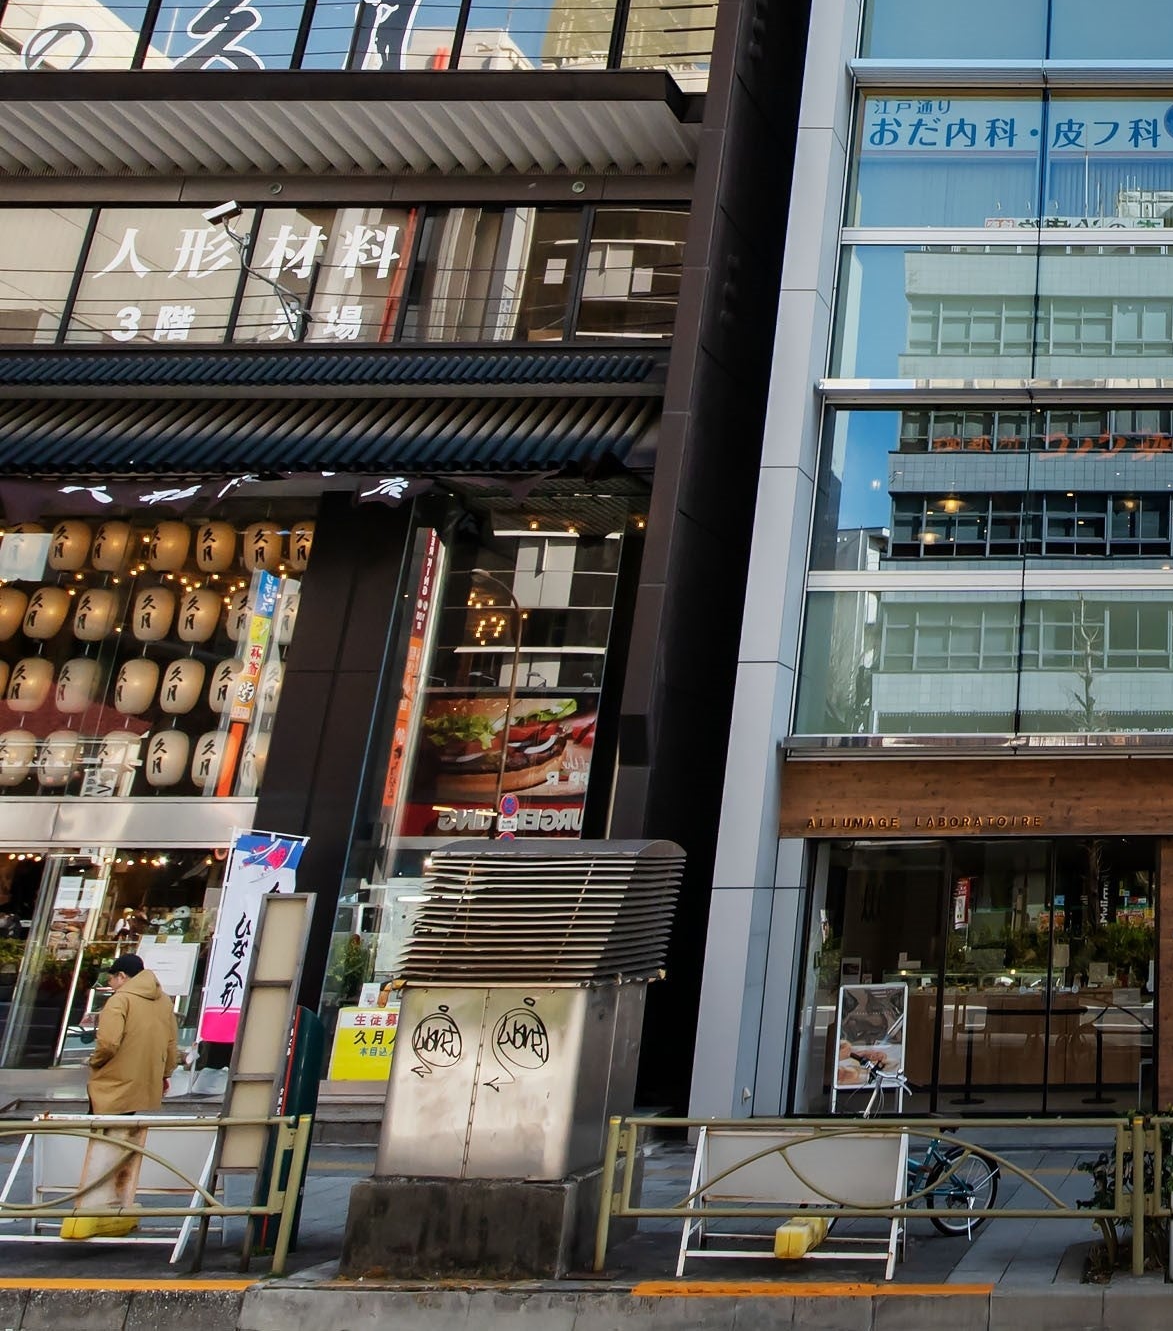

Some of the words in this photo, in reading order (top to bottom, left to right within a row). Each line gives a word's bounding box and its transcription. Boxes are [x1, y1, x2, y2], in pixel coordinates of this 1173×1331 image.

[873, 99, 952, 116] 江戸通り
[92, 224, 401, 280] 人形材料
[55, 526, 69, 558] 久月
[202, 528, 217, 562] 久月
[253, 529, 269, 563] 久月
[295, 528, 310, 561] 久月
[26, 593, 43, 627] 久月
[77, 595, 92, 630] 久月
[140, 594, 157, 629] 久月
[184, 595, 200, 630] 久月
[10, 665, 26, 700] 久月
[166, 666, 183, 702] 久月
[217, 666, 233, 701] 久月
[152, 738, 167, 774] 久月
[200, 739, 217, 776] 久月
[806, 817, 900, 829] ALLUMAGE
[914, 817, 1042, 829] LABORATOIRE
[219, 911, 253, 1015] ひな人形
